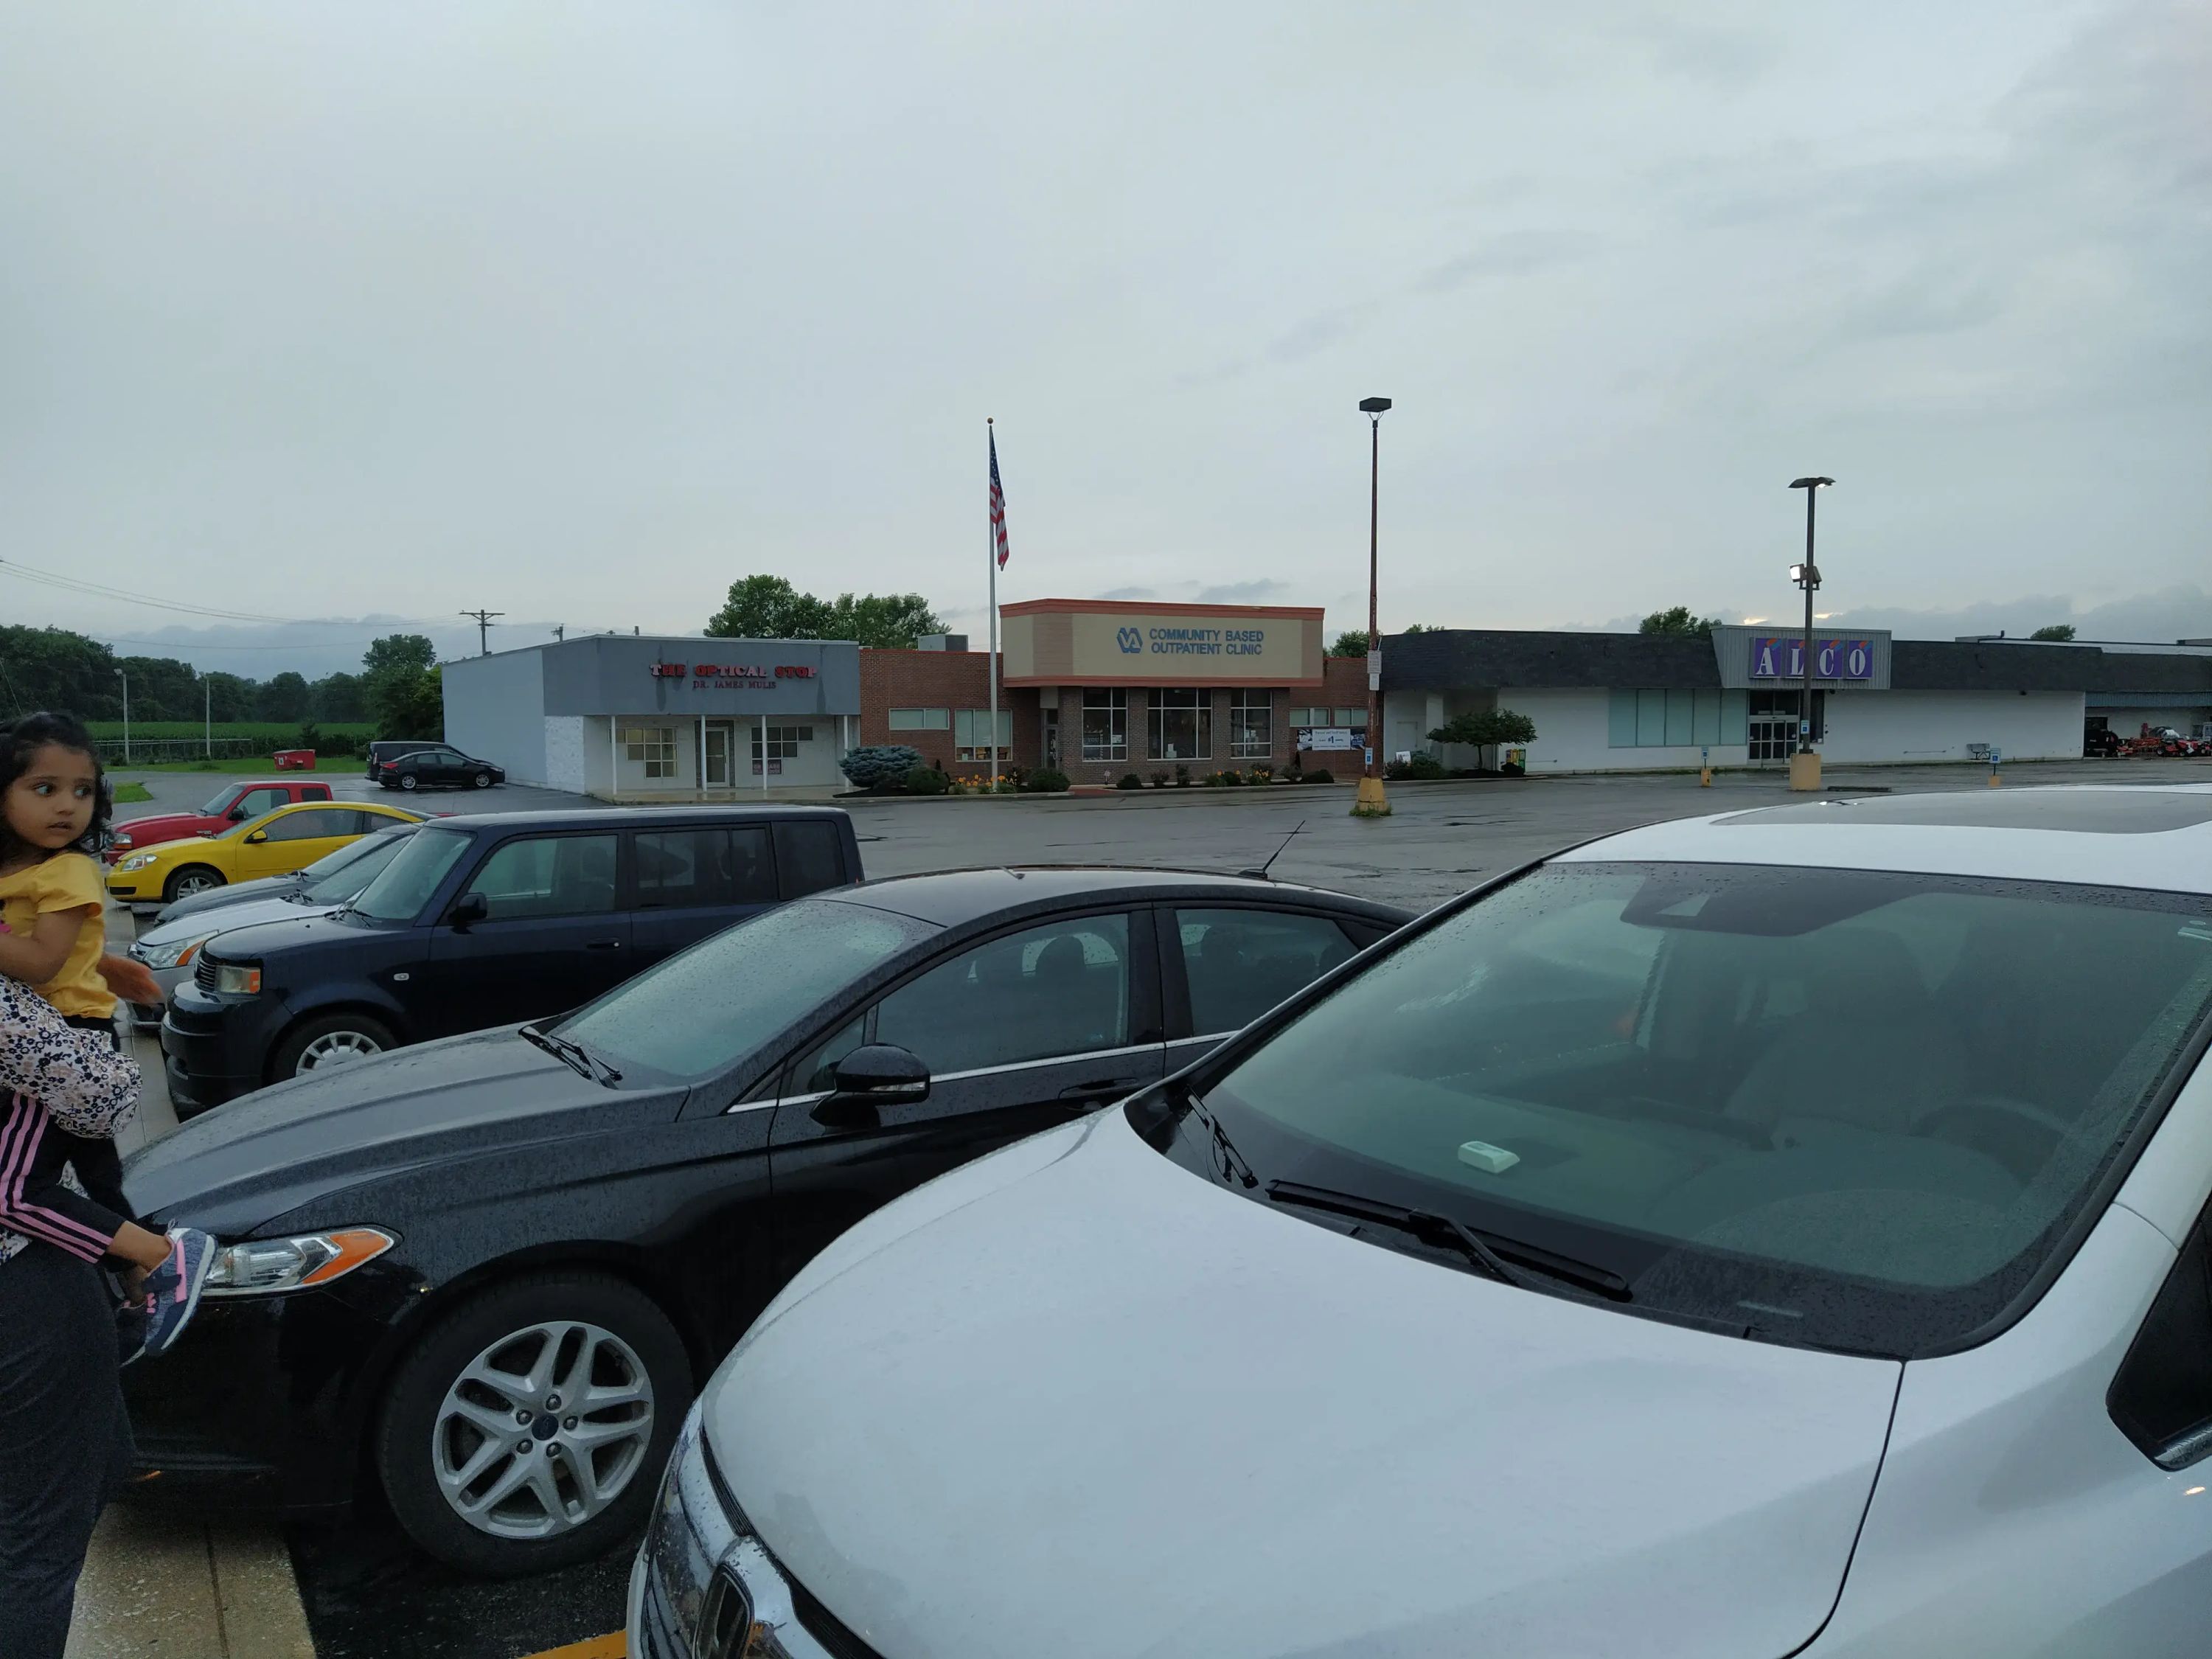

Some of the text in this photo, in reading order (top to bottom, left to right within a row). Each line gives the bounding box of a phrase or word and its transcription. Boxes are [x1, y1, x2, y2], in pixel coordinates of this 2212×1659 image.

[1149, 628, 1265, 642] COMMUNITY BASED
[1151, 642, 1262, 655] OUTPATIENT CLINIC
[1756, 647, 1865, 676] ALCO
[650, 664, 818, 678] THE OPTICAL STOP
[692, 680, 776, 689] DR. JAMES MULIS
